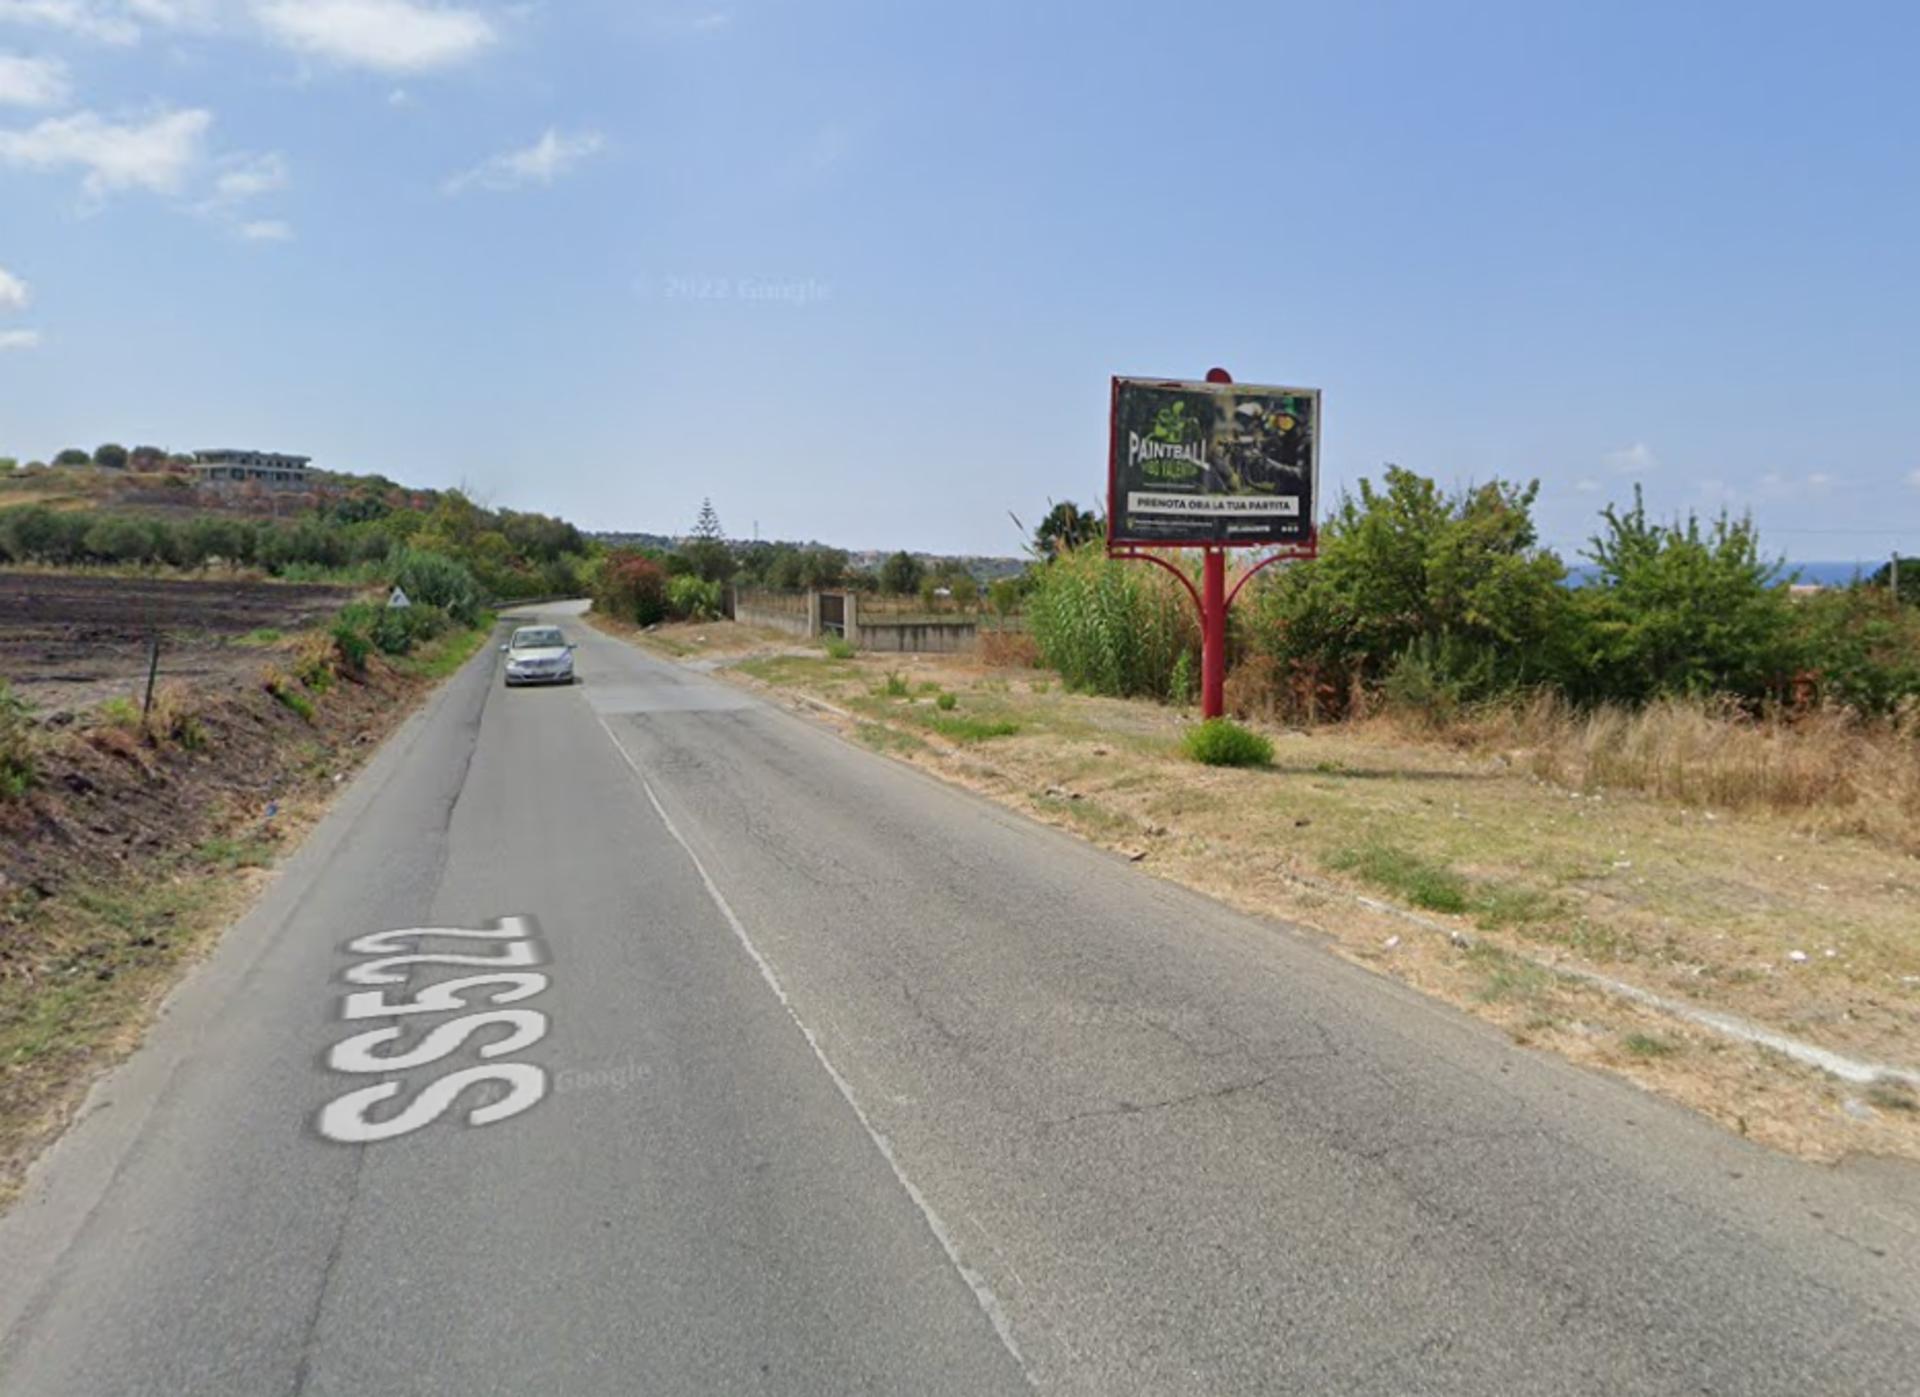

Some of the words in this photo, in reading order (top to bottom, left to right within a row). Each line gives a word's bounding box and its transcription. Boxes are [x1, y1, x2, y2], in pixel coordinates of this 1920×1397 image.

[1128, 429, 1210, 471] PAINTBALL
[1137, 497, 1186, 509] PRENOTA
[1189, 498, 1210, 509] ORA
[1213, 499, 1224, 510] LA
[1227, 499, 1246, 510] TUA
[1248, 500, 1290, 511] PARTITA
[319, 915, 547, 1142] SS522
